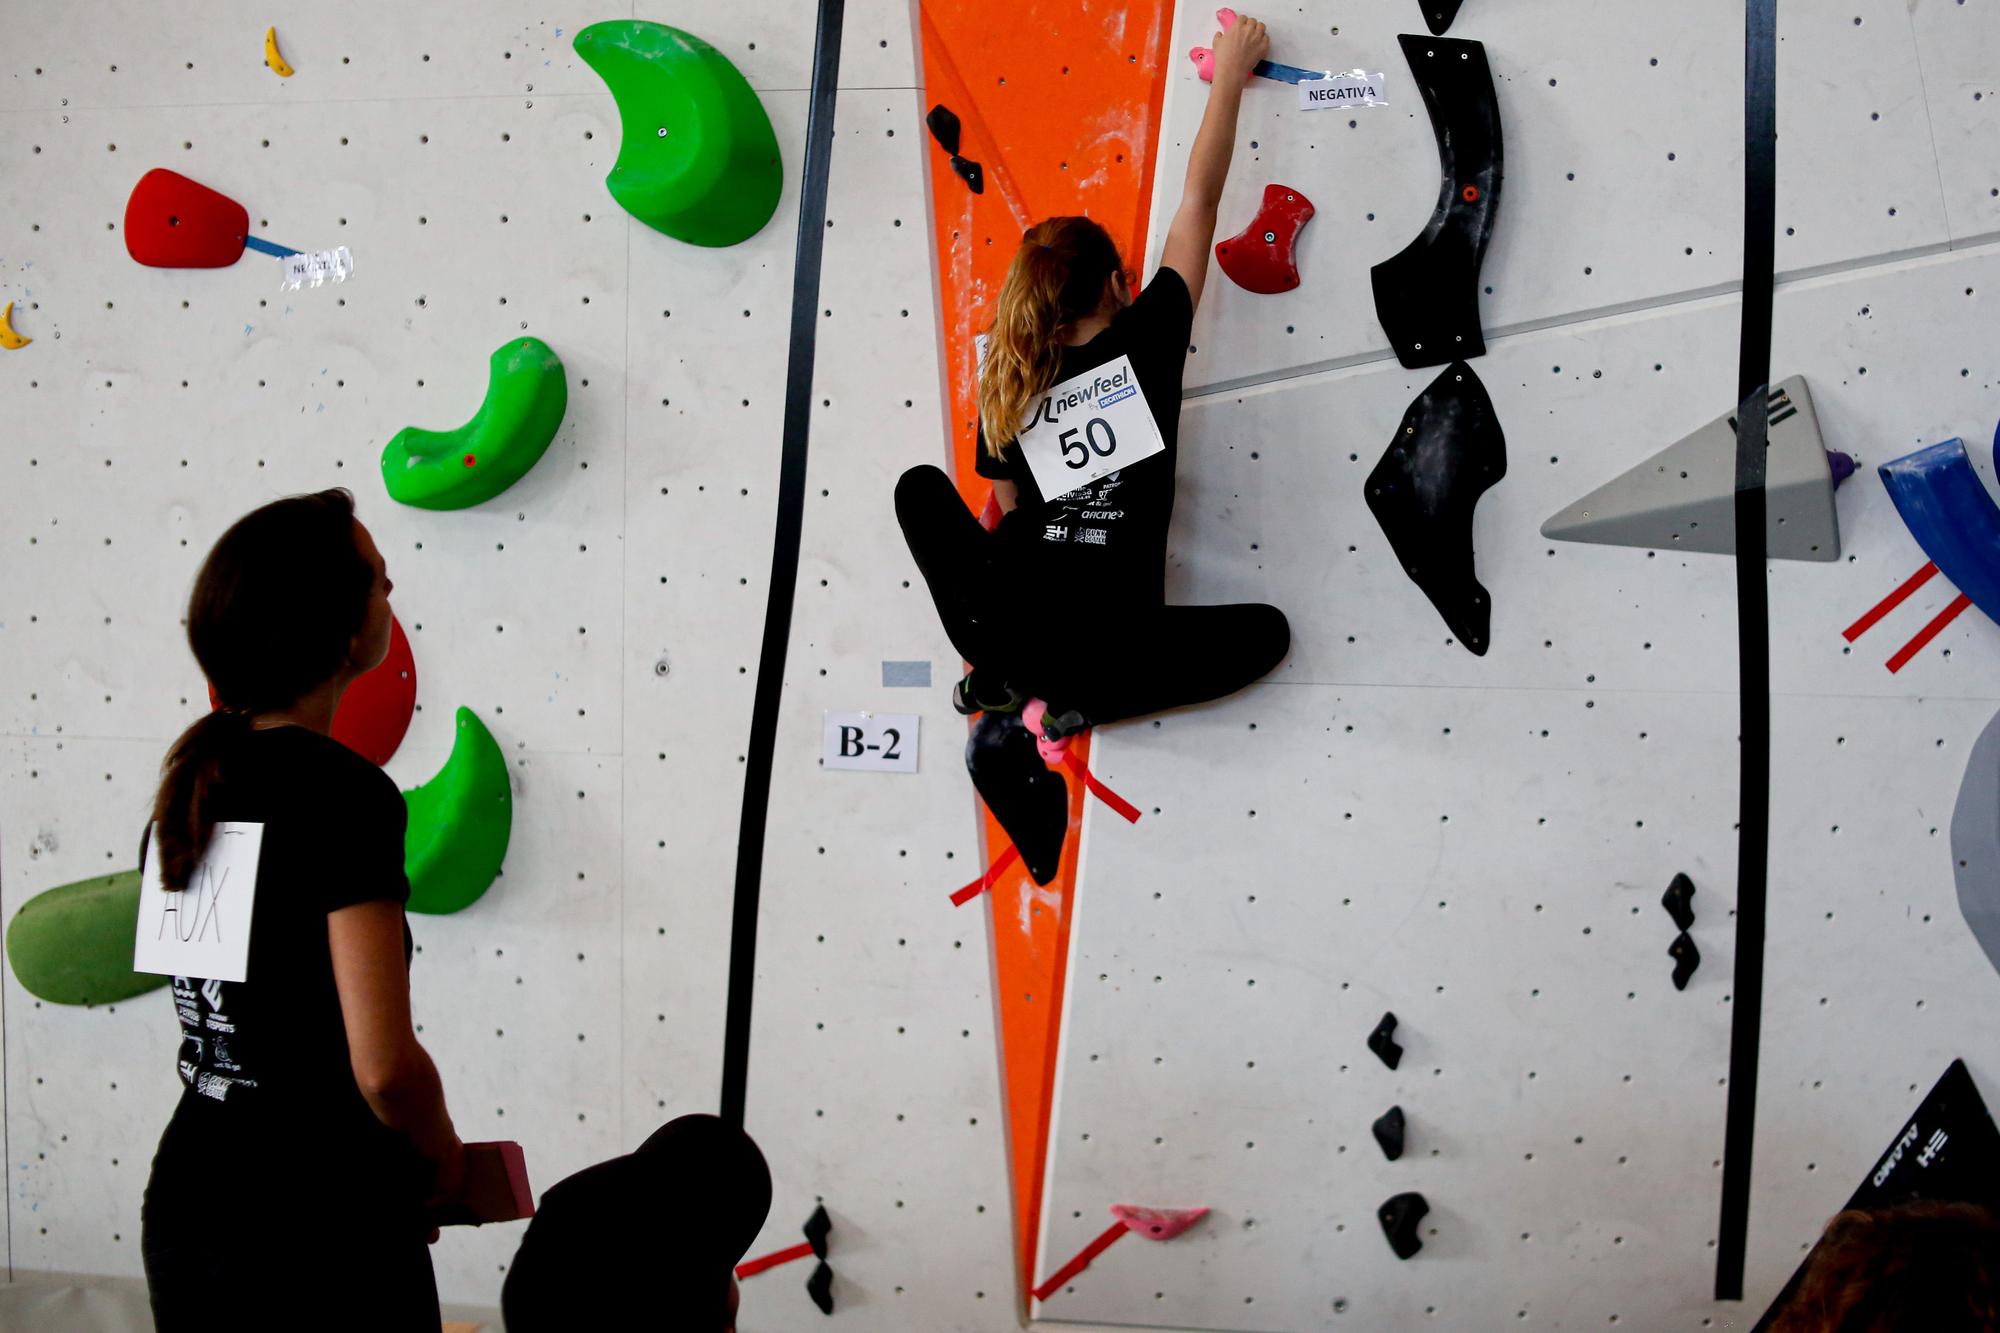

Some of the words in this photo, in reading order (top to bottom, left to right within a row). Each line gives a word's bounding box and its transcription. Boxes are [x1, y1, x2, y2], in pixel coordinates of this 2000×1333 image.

[1309, 86, 1376, 101] NEGATIVA
[1056, 366, 1128, 414] newfeel
[1059, 418, 1117, 470] 50
[837, 725, 901, 760] B-2
[158, 862, 229, 943] AUX
